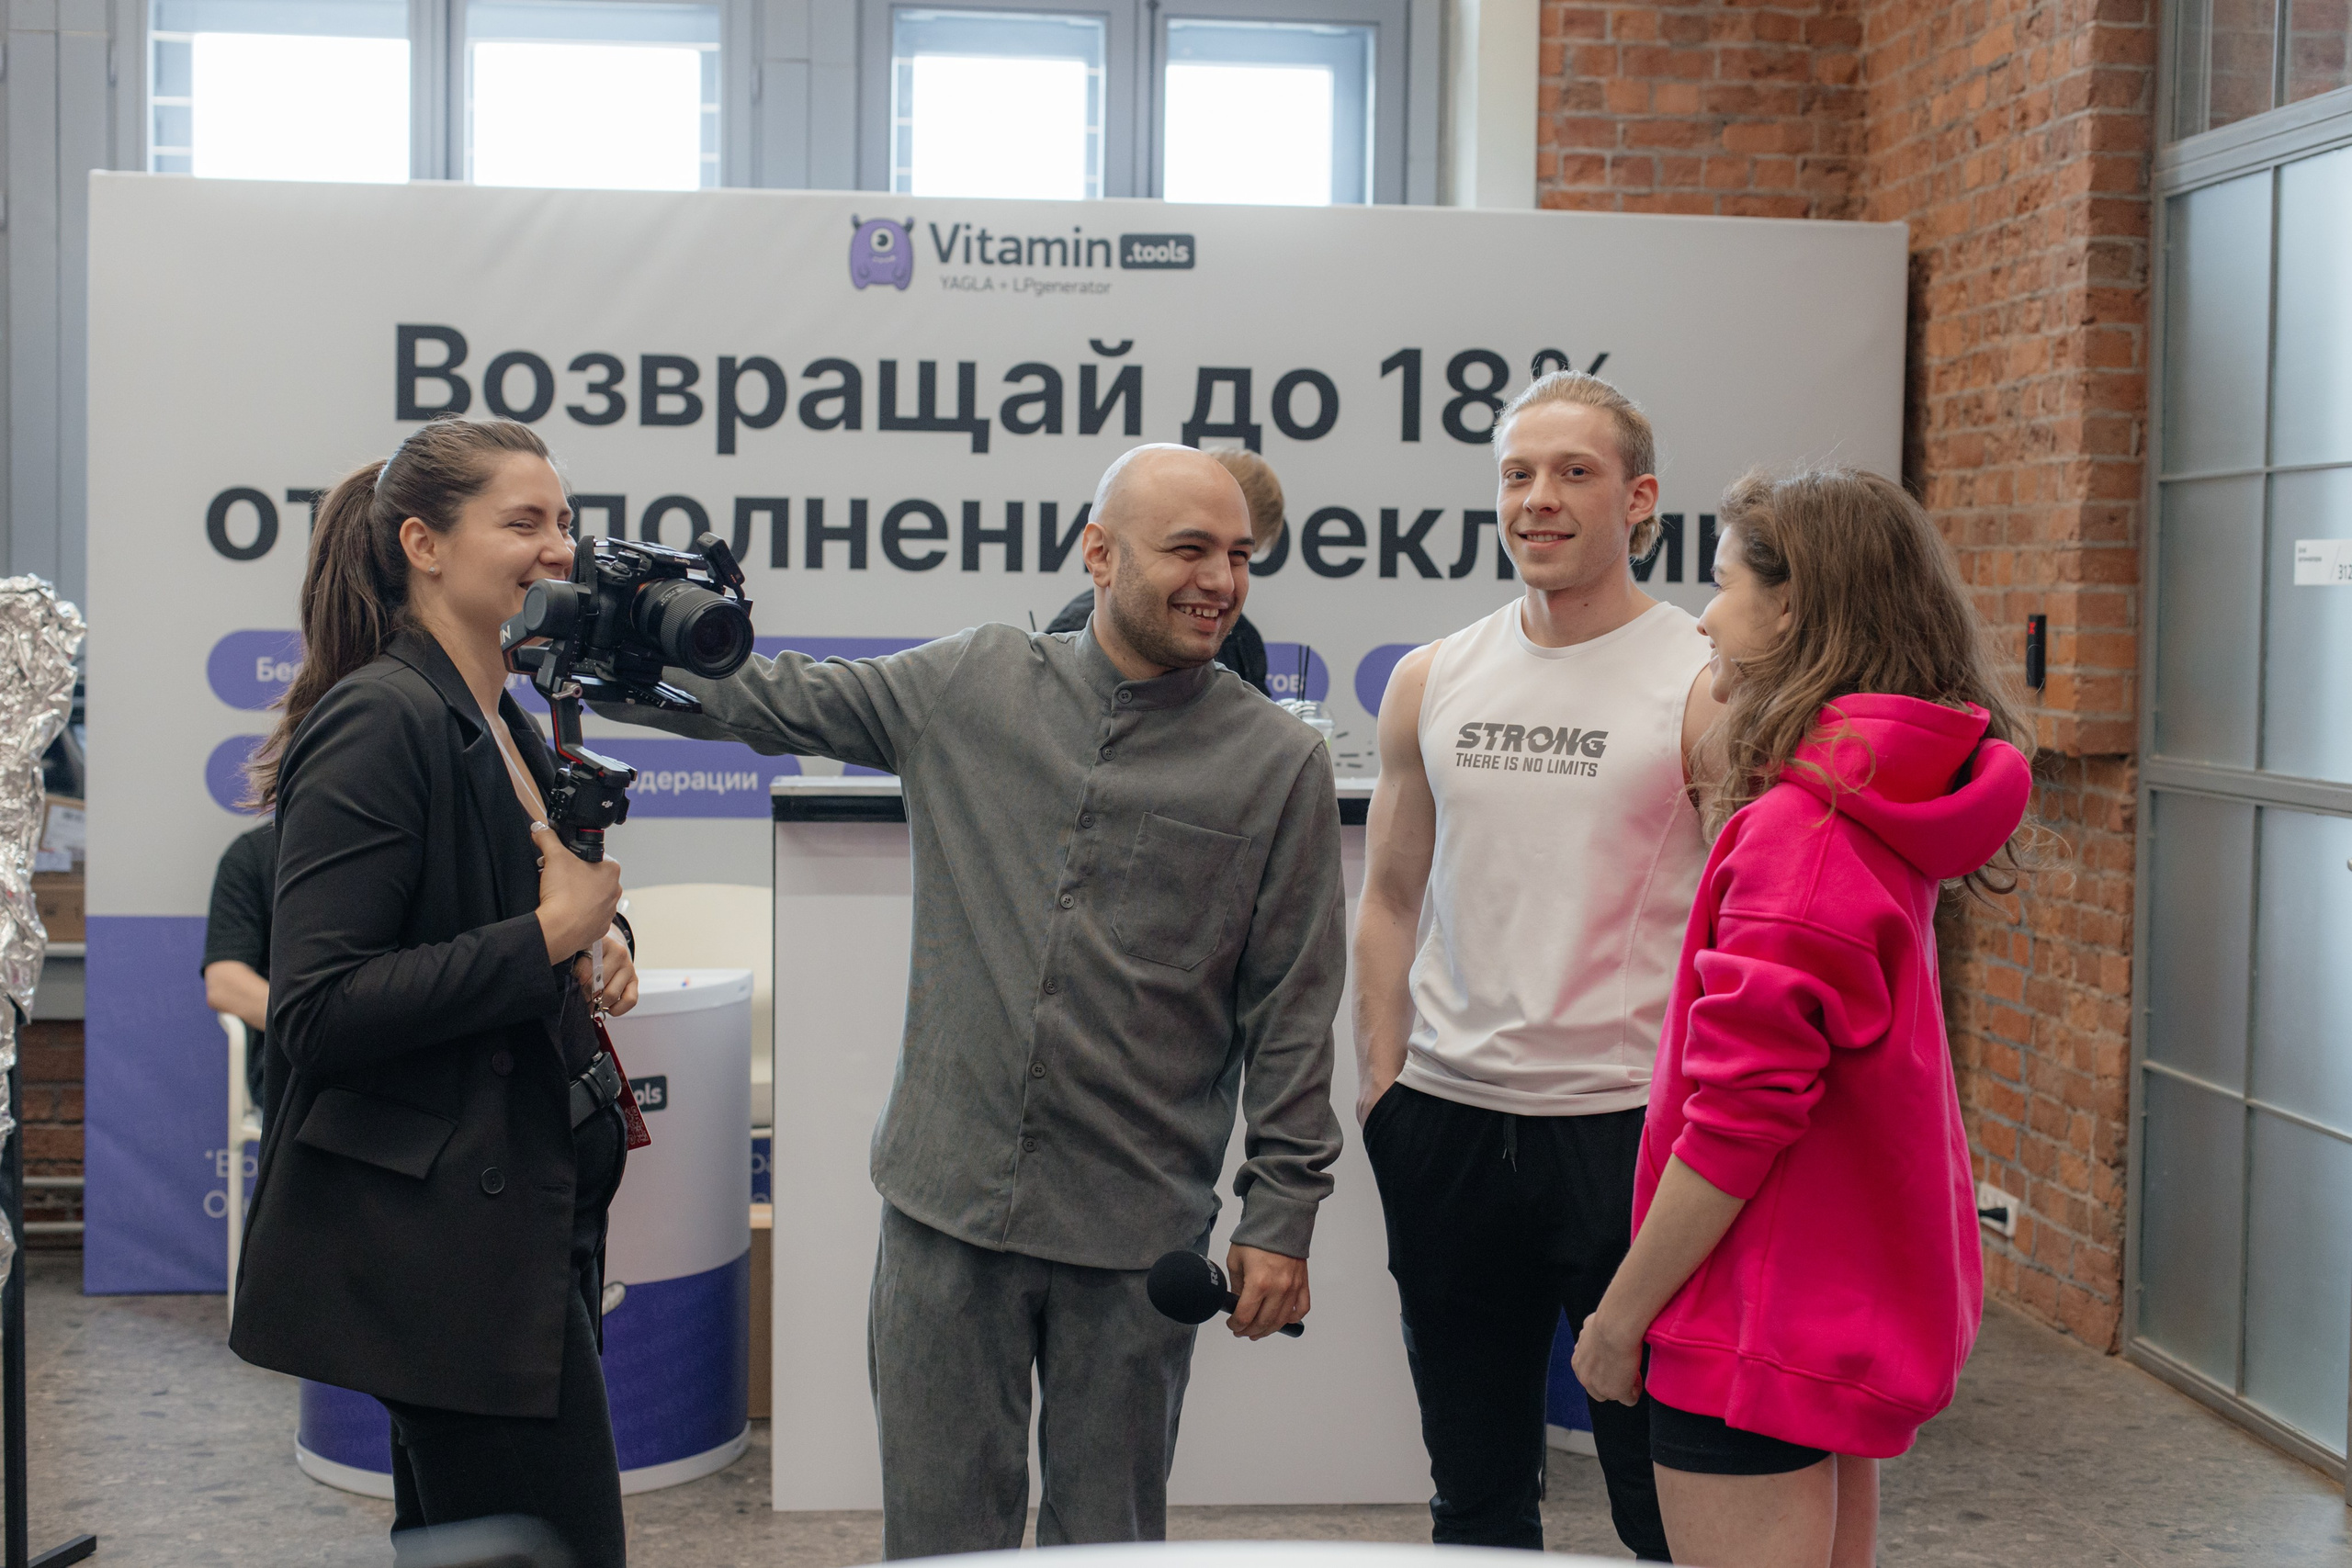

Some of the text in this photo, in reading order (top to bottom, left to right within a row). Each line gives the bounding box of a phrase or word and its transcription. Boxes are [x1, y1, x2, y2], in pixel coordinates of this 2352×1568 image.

[929, 222, 1189, 267] Vitamin .tools
[940, 276, 994, 292] YAGLA
[1012, 277, 1112, 296] LPgenerator
[395, 322, 1143, 456] Возвращай
[1182, 365, 1340, 453] до
[567, 491, 1093, 573] полнени
[1455, 722, 1609, 759] STRONG
[627, 770, 759, 795] дерации
[1455, 752, 1599, 778] THERE IS NO LIMITS
